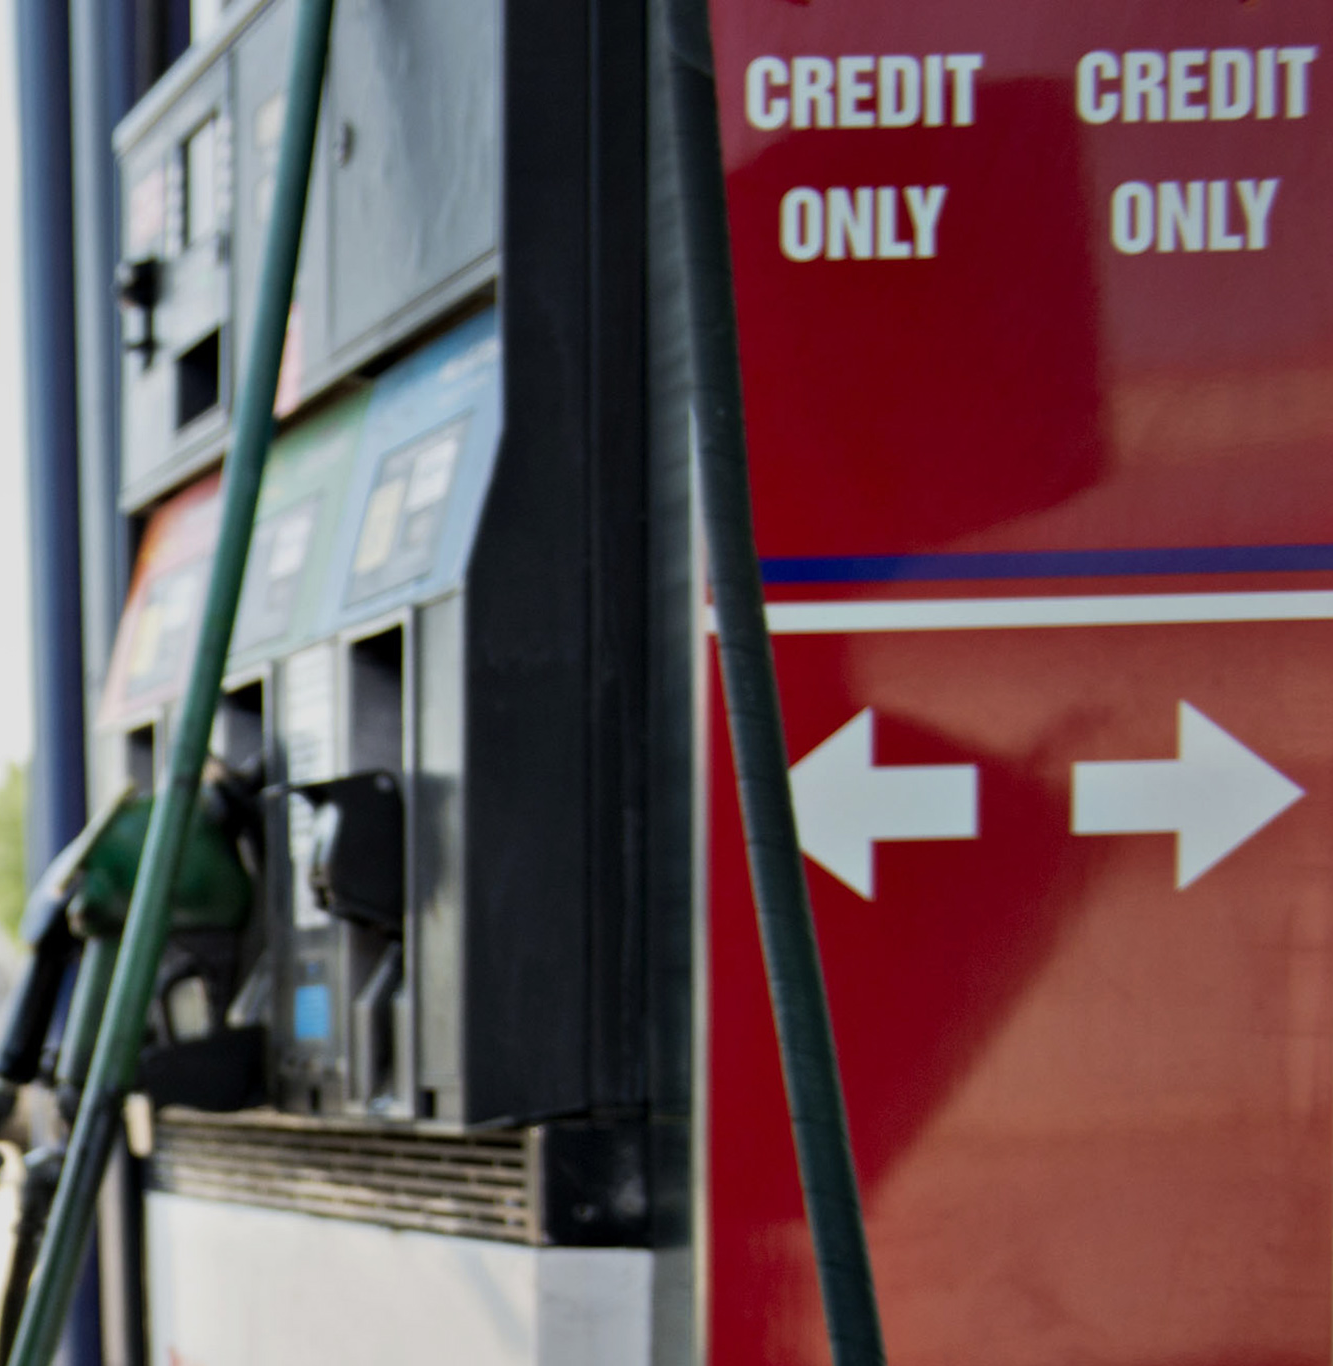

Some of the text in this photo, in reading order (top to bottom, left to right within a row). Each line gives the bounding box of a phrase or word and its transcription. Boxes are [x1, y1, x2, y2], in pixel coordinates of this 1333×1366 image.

[745, 54, 983, 130] CREDIT
[1076, 47, 1317, 124] CREDIT
[780, 186, 947, 261] ONLY
[1111, 179, 1280, 255] ONLY
